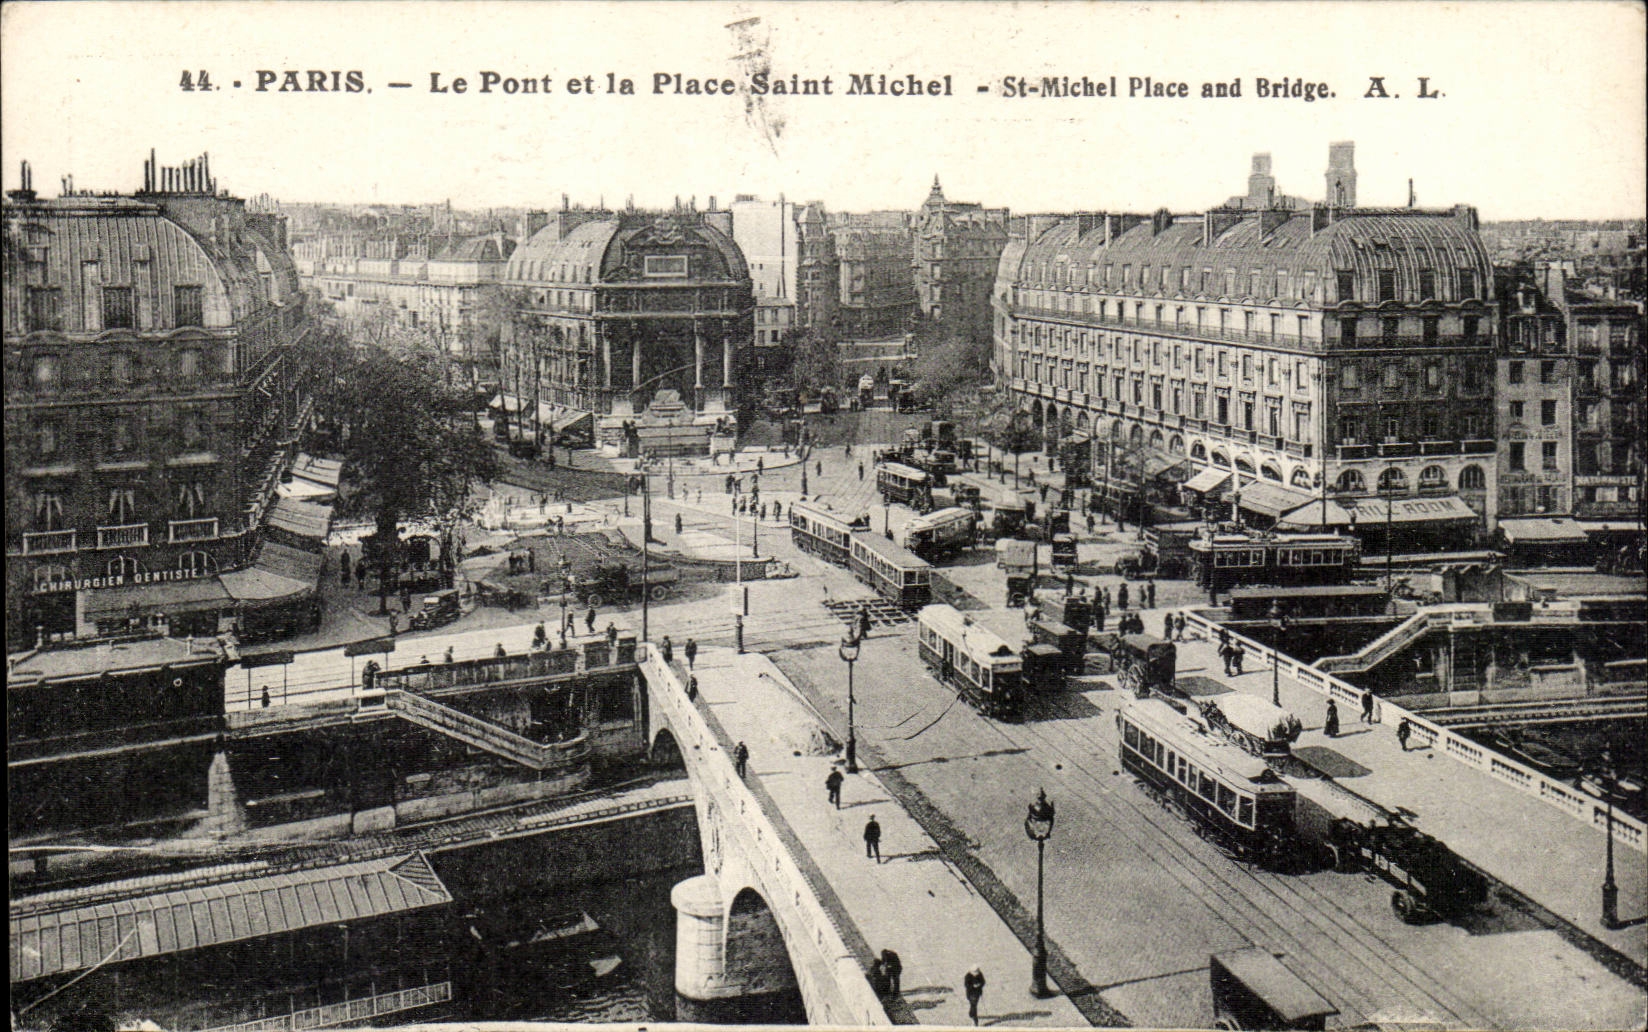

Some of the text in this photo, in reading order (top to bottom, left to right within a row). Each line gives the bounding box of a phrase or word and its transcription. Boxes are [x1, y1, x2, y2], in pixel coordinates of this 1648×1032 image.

[1402, 500, 1457, 515] ROOM
[39, 568, 199, 593] CHIRURGIEN DENTISTE
